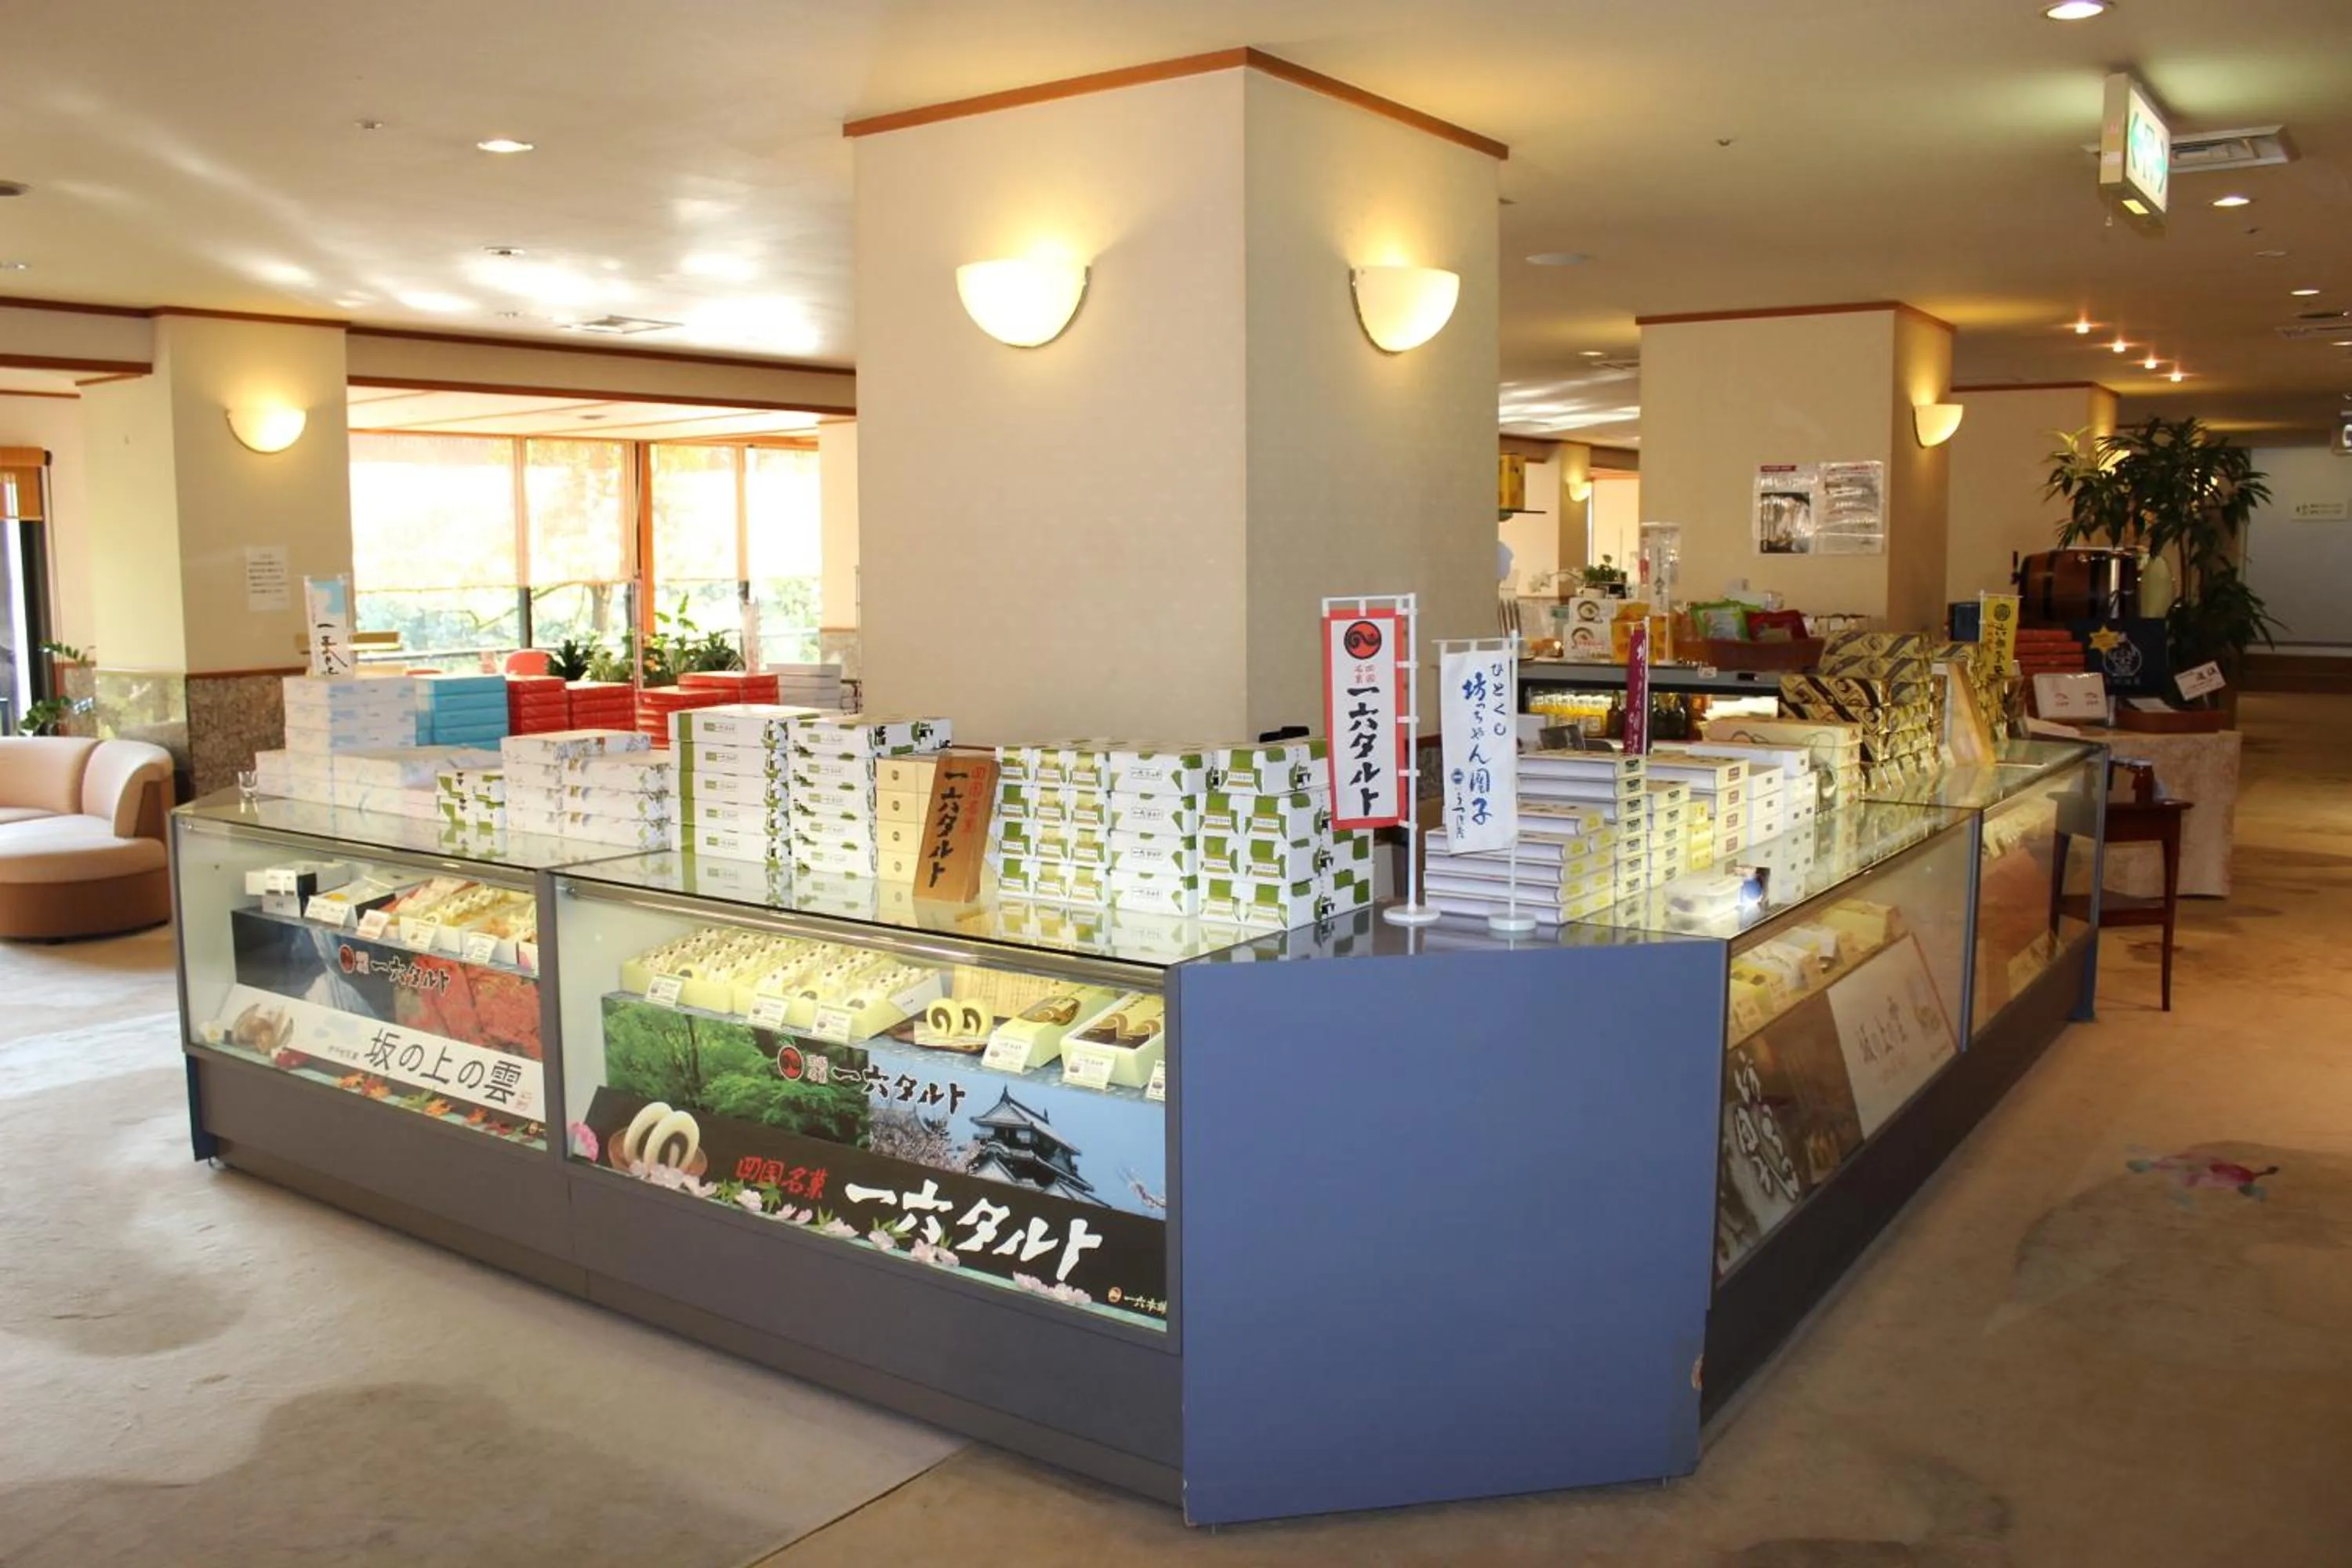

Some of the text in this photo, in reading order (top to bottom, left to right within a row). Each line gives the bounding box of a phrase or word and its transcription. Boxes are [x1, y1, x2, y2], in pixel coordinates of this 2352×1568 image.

[1346, 686, 1381, 816] 一六タルト
[927, 771, 968, 888] 一六タルト
[370, 954, 451, 997] 一六タルト
[364, 1028, 522, 1105] 坂の上の雲
[830, 1063, 966, 1116] 一六タルト
[844, 1178, 1103, 1283] 一六タルト
